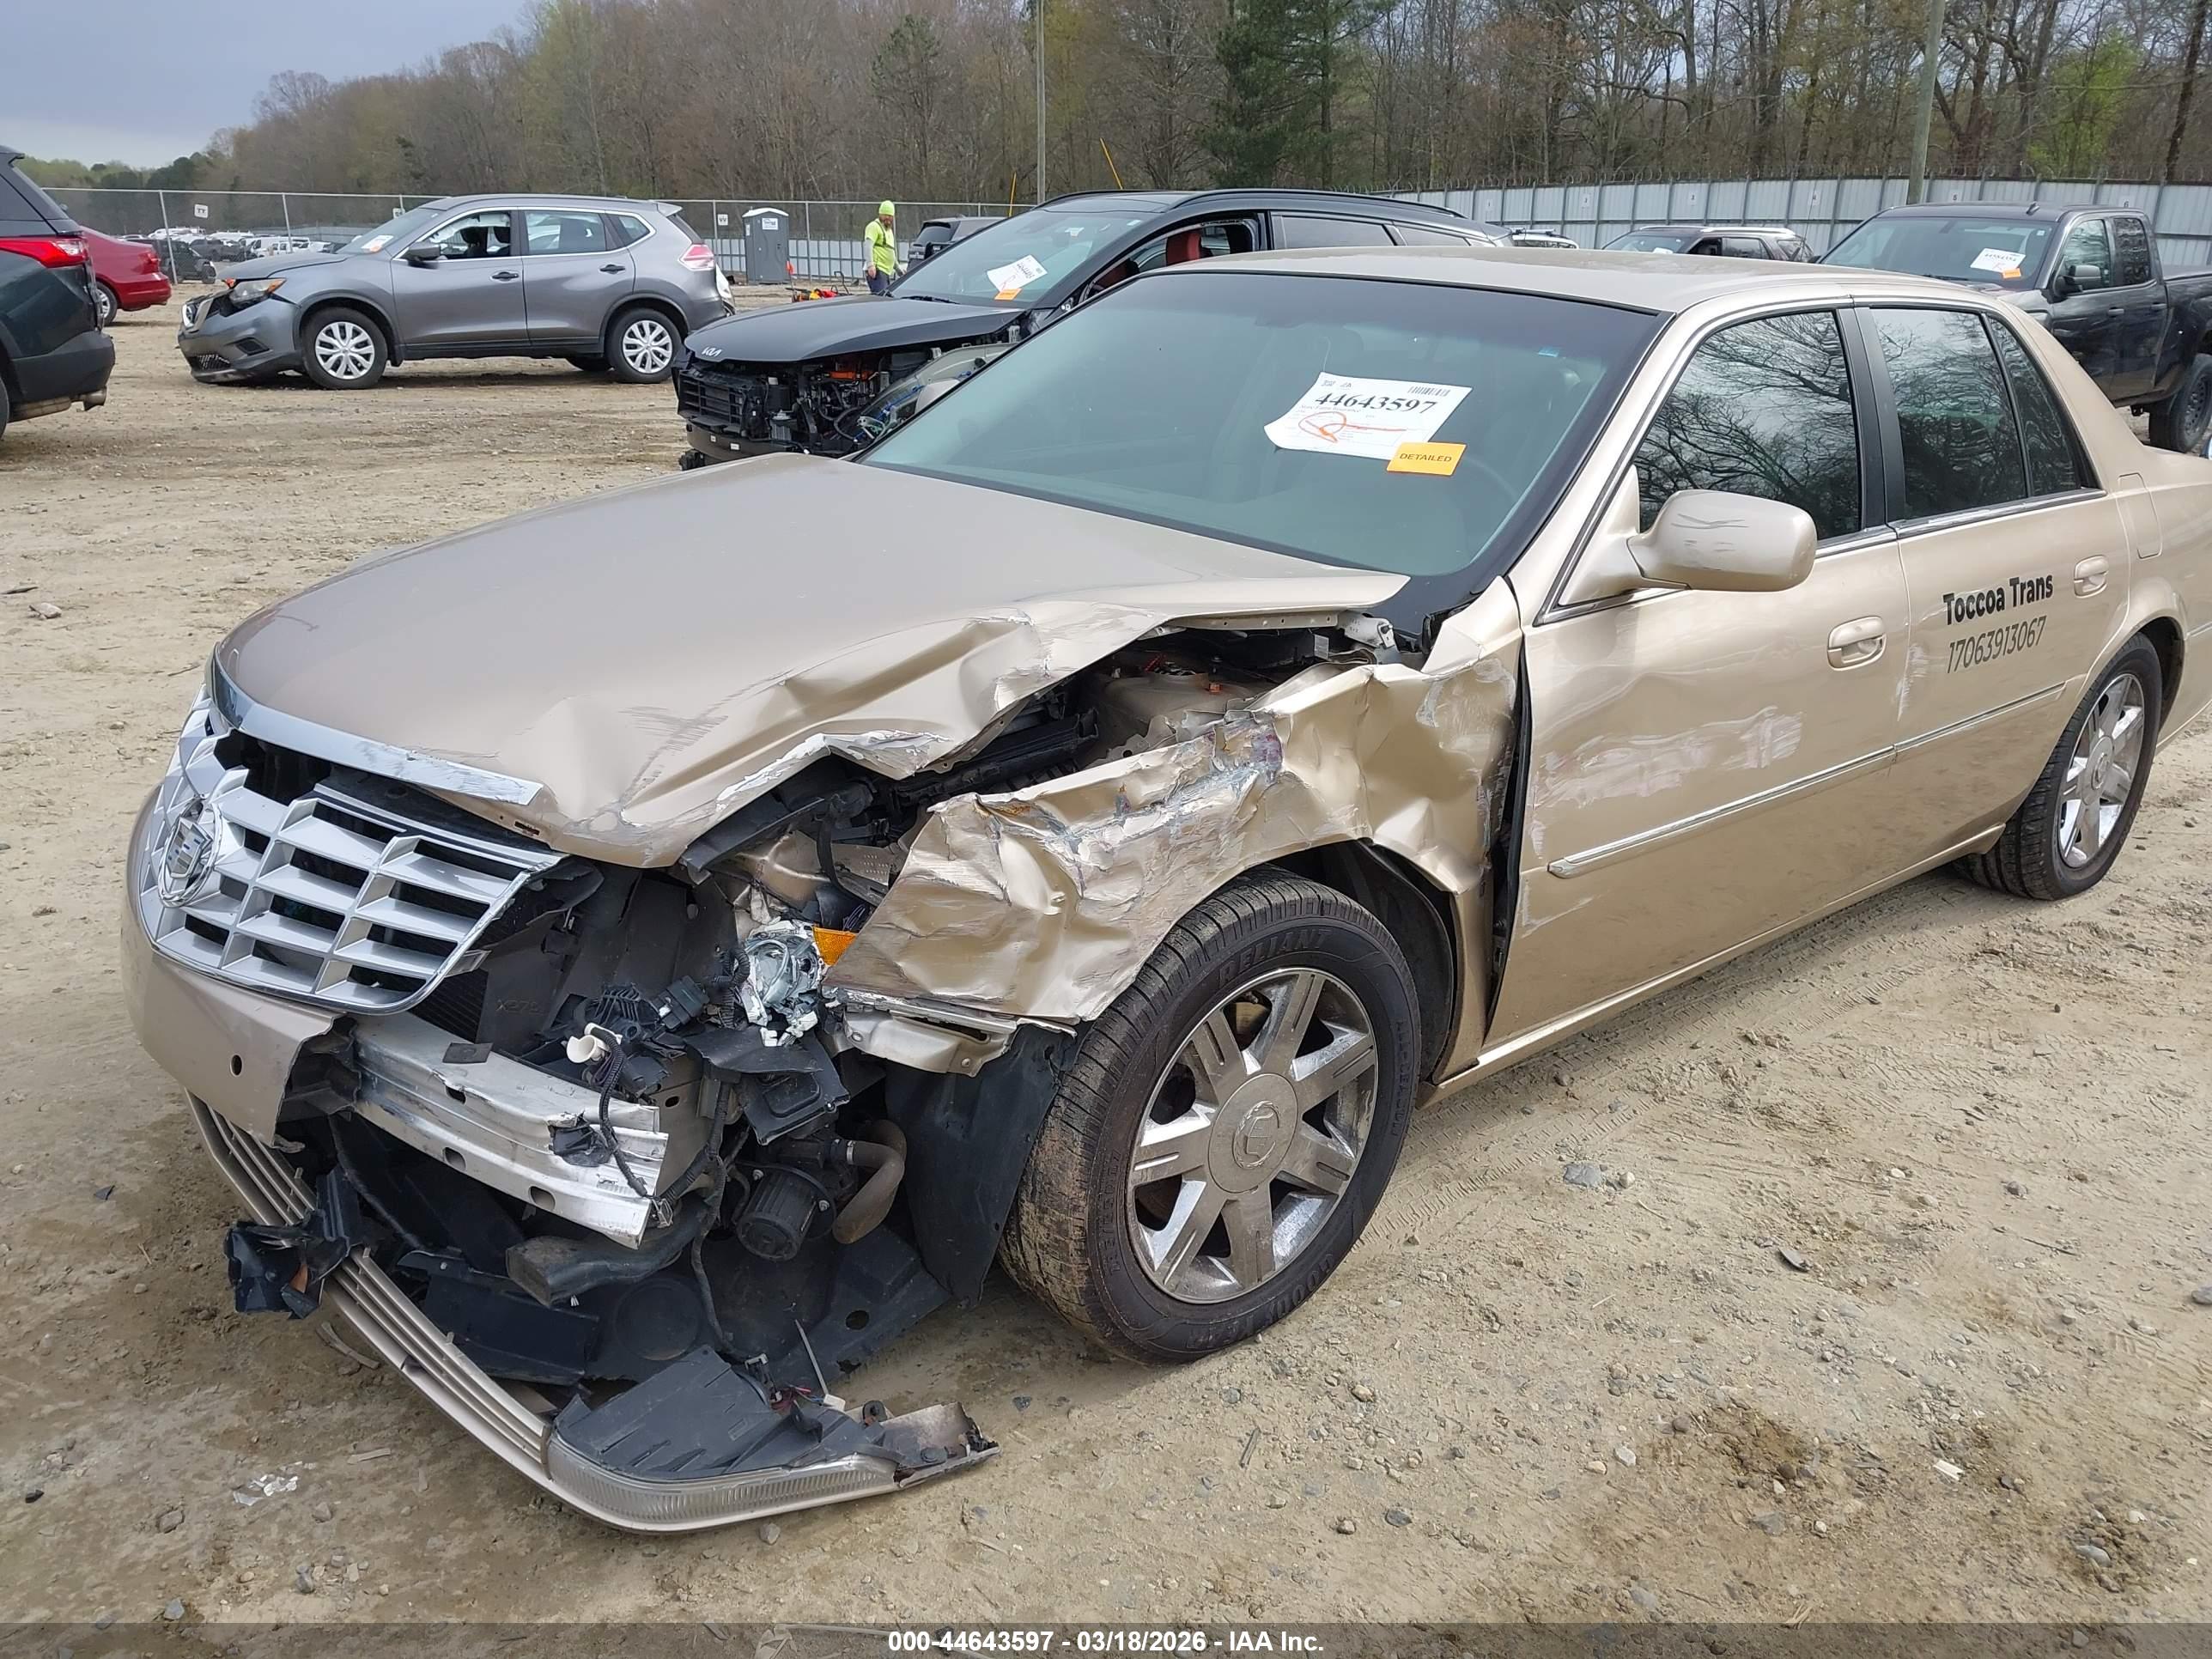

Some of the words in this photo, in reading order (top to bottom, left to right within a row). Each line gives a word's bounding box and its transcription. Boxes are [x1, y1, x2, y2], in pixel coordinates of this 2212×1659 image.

[1316, 392, 1437, 414] 44643597
[1400, 453, 1452, 463] DETAILED
[1942, 586, 2005, 625] Toccoa
[2009, 574, 2054, 607] Trans
[1947, 615, 2047, 674] 17063913067
[1218, 928, 1333, 988] RELIANT
